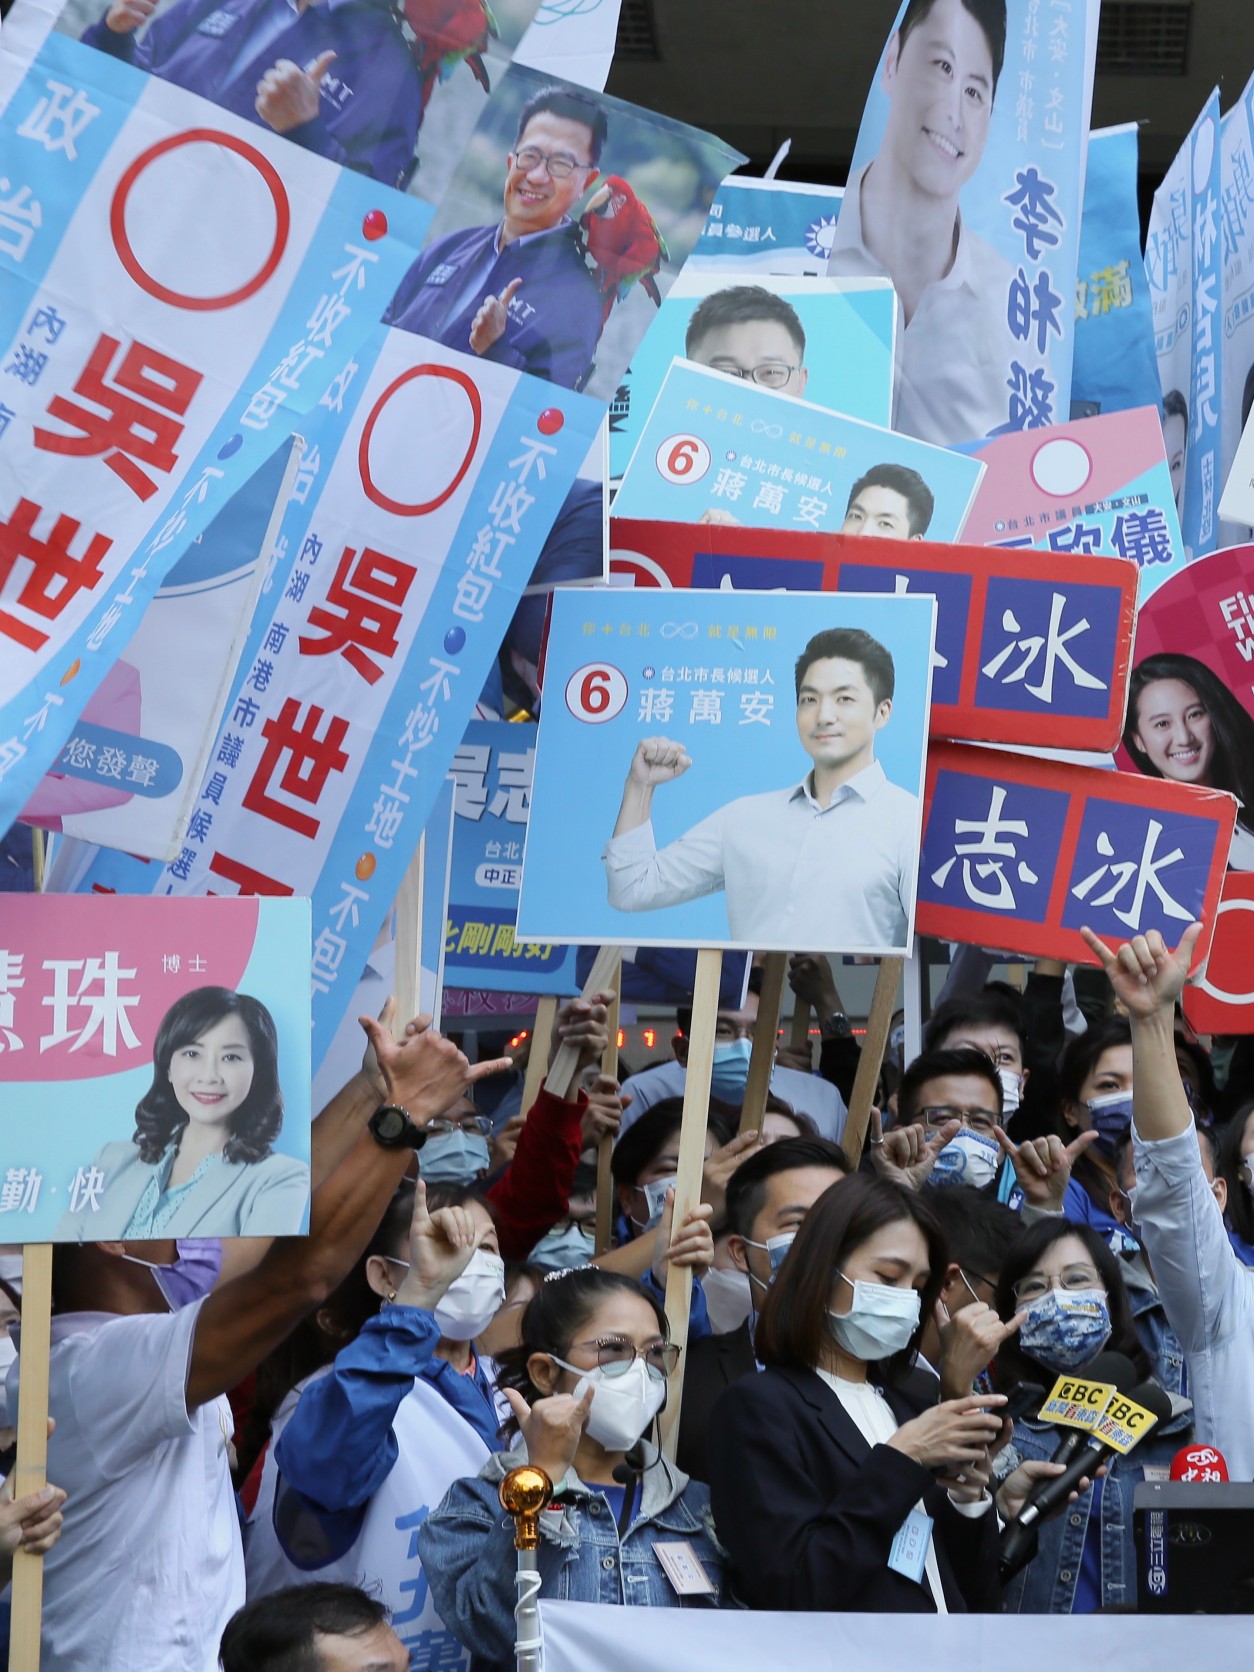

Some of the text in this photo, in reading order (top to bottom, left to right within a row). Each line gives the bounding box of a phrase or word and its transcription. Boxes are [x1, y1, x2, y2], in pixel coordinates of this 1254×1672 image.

[667, 440, 699, 476] 6
[740, 454, 833, 496] 台北市長候選人
[709, 467, 828, 529] 蔣萬安
[453, 435, 557, 622] 不收紅包
[989, 507, 1175, 570] 欣儀
[579, 669, 612, 715] 6
[660, 665, 776, 686] 台北市長候選人
[636, 687, 776, 727] 蔣萬安
[364, 656, 461, 849] 不炒土地
[931, 785, 1196, 931] 志冰
[161, 953, 208, 974] 博士
